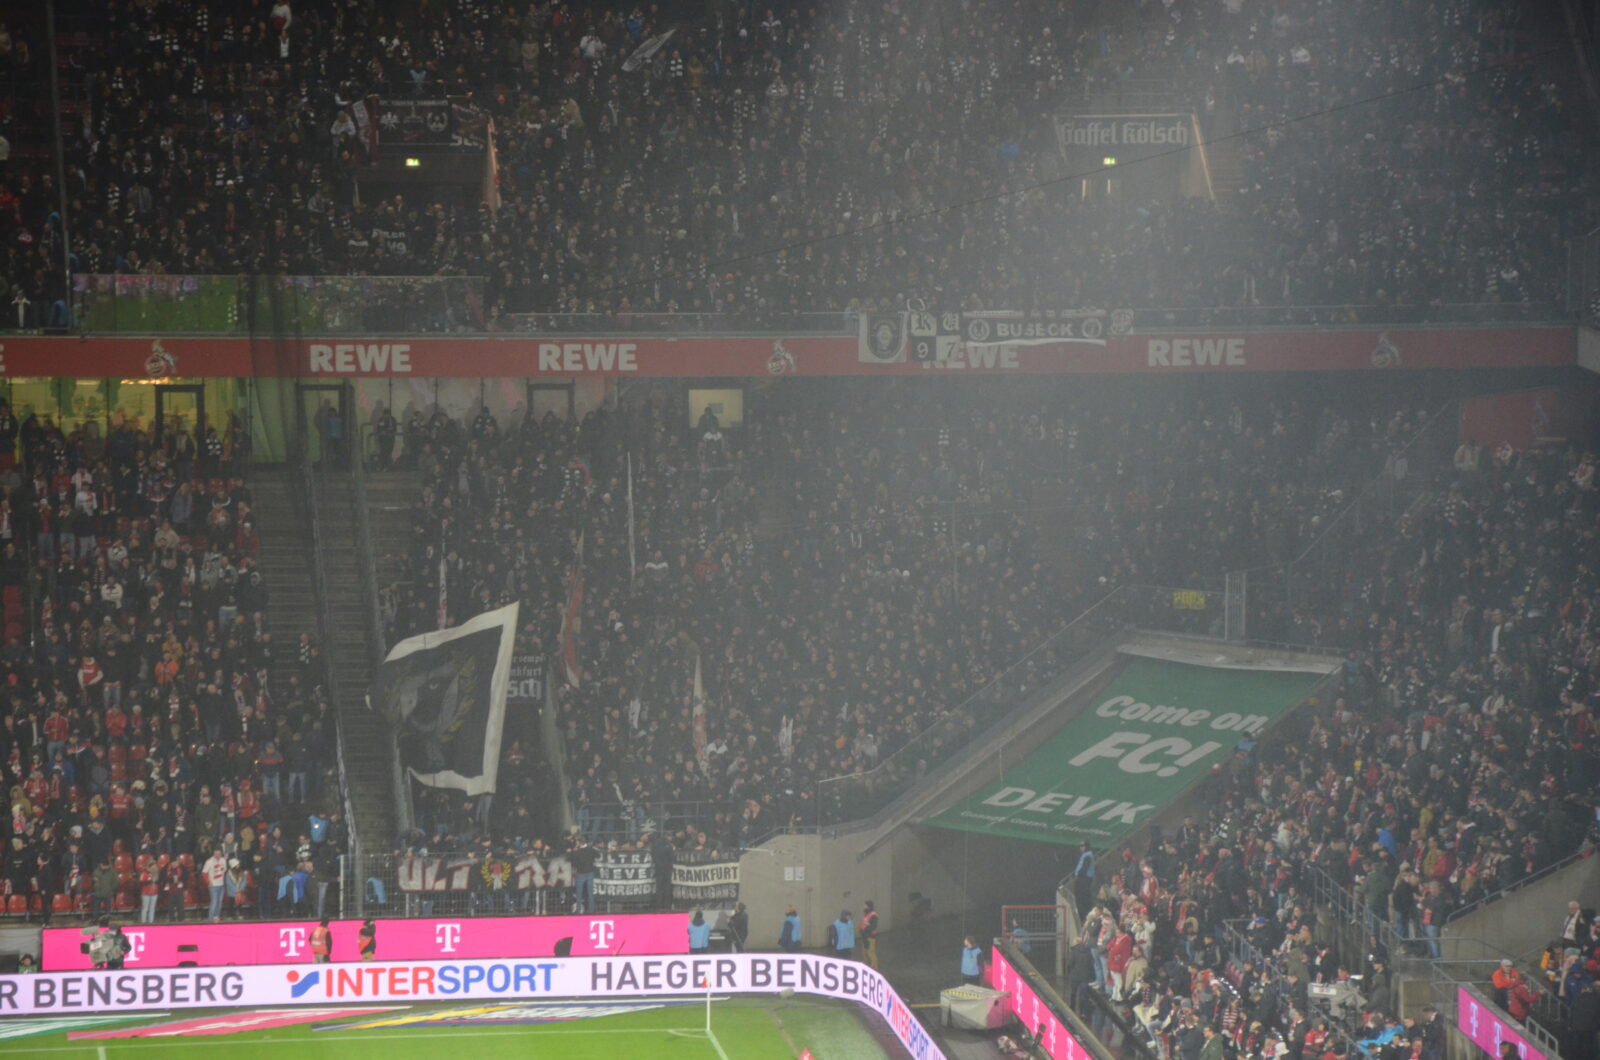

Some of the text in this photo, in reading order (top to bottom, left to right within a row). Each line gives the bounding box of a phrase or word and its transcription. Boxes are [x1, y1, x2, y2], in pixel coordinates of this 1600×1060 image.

[1060, 121, 1189, 146] Gaffel Kölsch
[997, 323, 1073, 337] BUSECK
[311, 344, 412, 372] REWE
[539, 343, 638, 371] REWE
[1148, 339, 1245, 366] REWE
[1096, 695, 1211, 727] Come
[1068, 731, 1222, 777] FC!
[981, 786, 1156, 825] DEVK
[34, 972, 243, 1009] BENSBERG
[326, 963, 559, 997] INTERSPORT
[592, 959, 884, 1008] HAEGER BENSBERG
